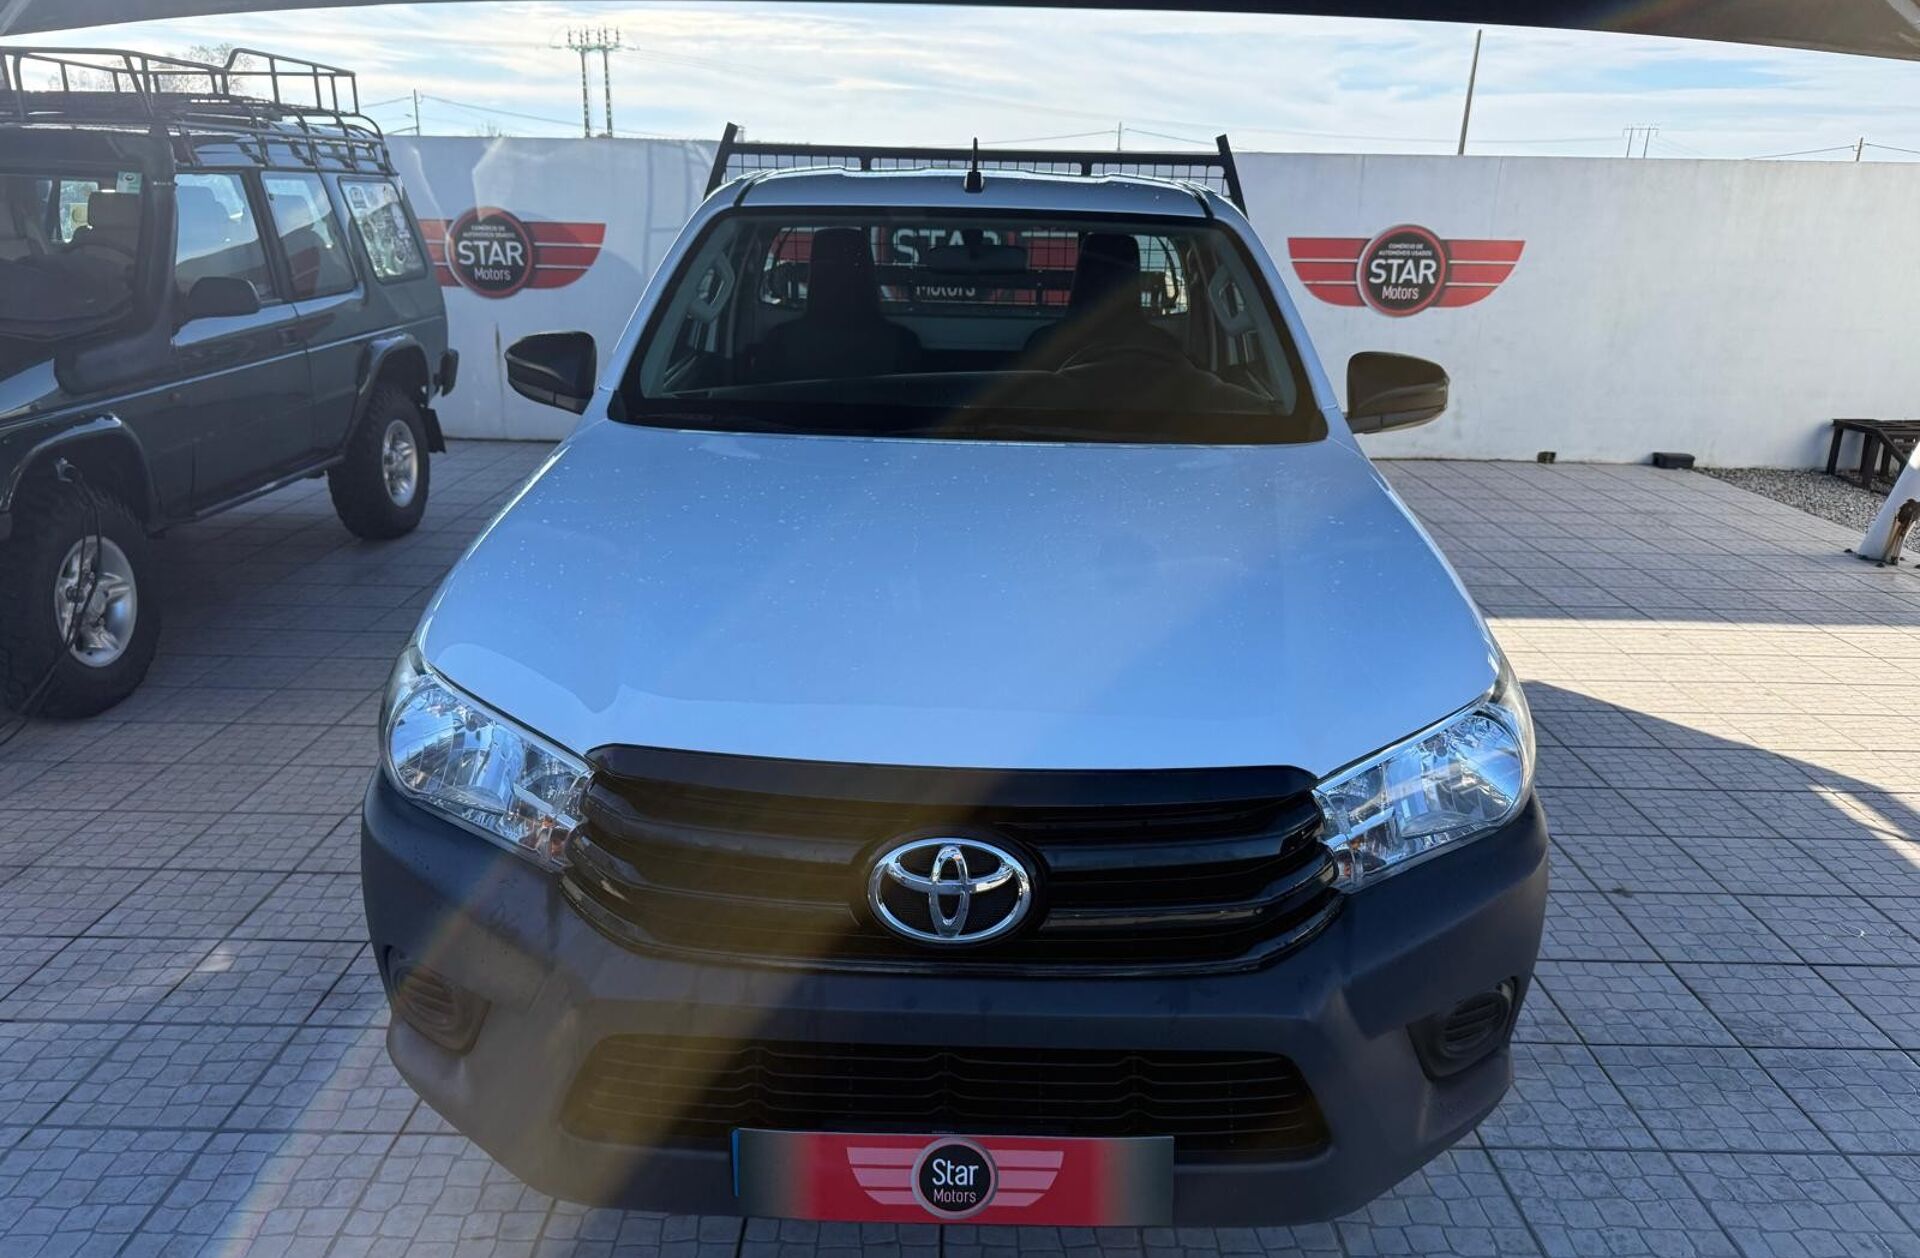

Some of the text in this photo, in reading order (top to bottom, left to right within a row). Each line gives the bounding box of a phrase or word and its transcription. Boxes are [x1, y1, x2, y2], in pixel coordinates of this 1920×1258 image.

[457, 240, 524, 266] STAR
[474, 267, 511, 280] Motors
[1369, 258, 1437, 285] STAR
[1381, 285, 1419, 300] Motors
[932, 1158, 979, 1186] Star
[933, 1188, 977, 1204] Motors
